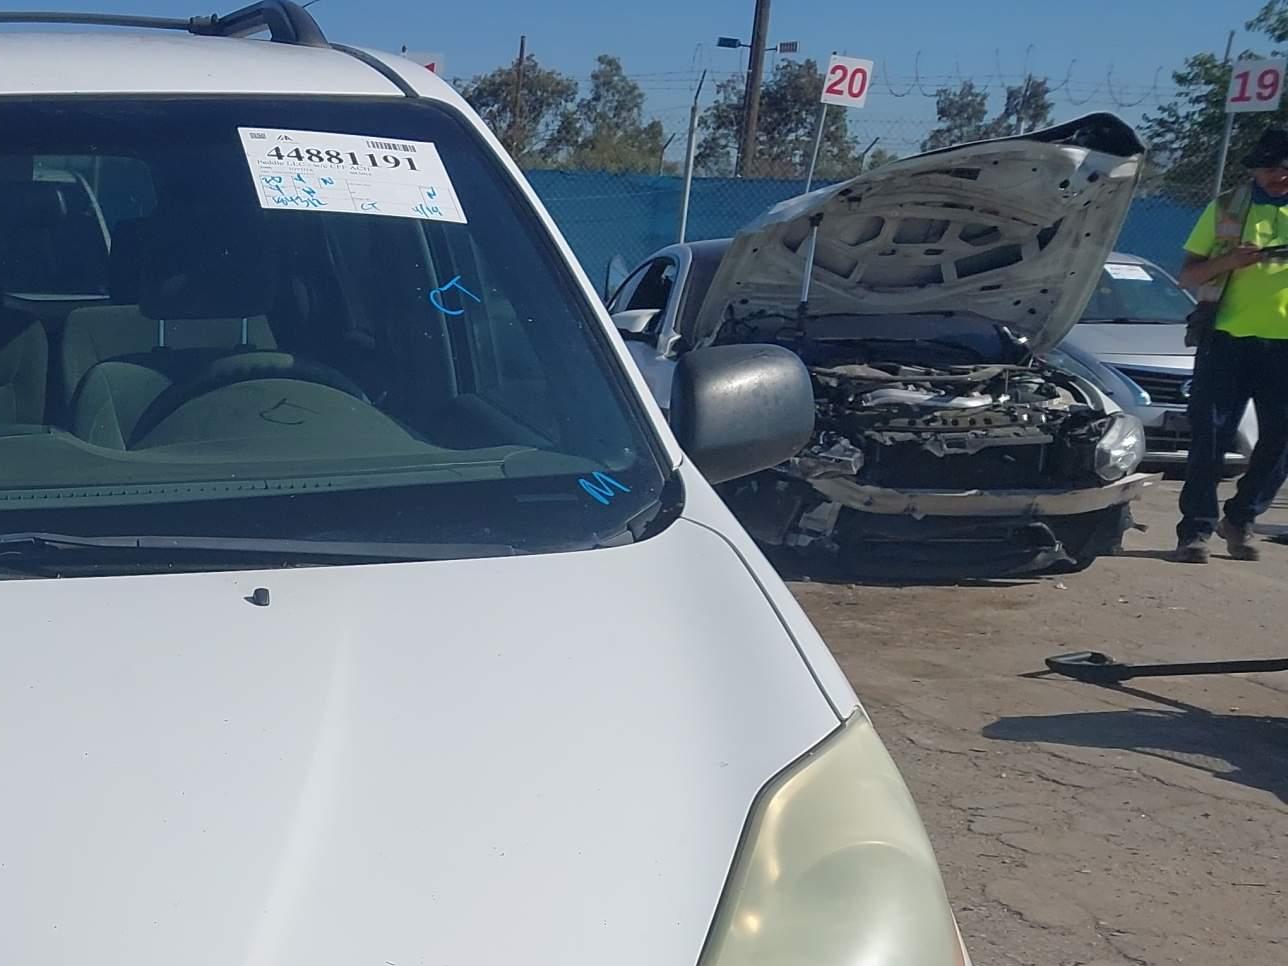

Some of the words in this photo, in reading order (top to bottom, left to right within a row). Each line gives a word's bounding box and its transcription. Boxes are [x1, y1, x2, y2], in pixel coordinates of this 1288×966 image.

[825, 65, 868, 98] 20
[1230, 69, 1280, 102] 19
[267, 145, 422, 172] 44881191
